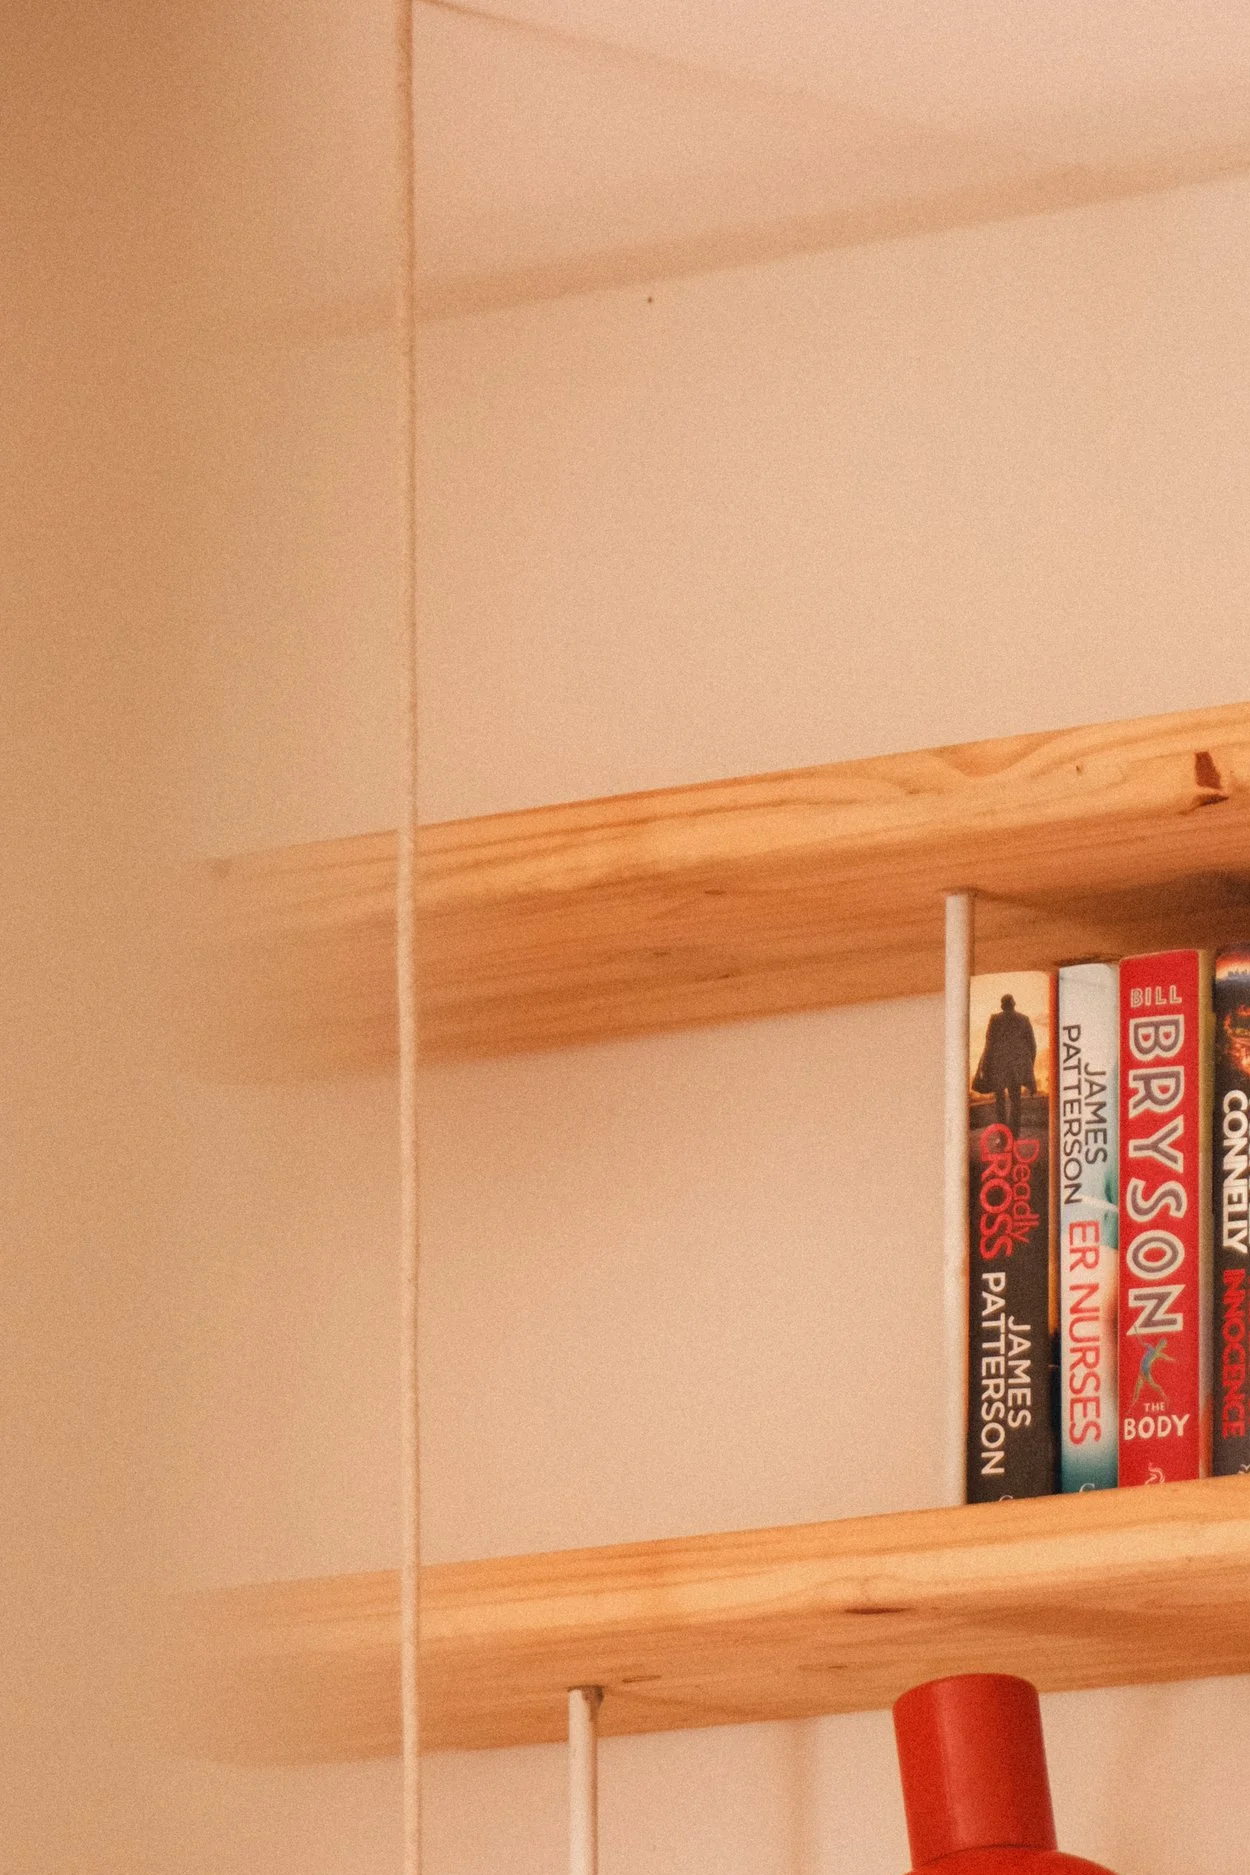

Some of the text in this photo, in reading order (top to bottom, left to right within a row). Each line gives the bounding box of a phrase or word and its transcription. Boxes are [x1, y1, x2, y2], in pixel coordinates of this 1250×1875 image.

[1130, 986, 1182, 1008] BILL
[1062, 1024, 1083, 1204] PATTERSON
[1084, 1061, 1108, 1164] JAMES
[1126, 1015, 1187, 1335] BRYSON
[1222, 1089, 1248, 1254] CONNELLY
[980, 1123, 1014, 1258] CROSS
[1010, 1136, 1040, 1244] Deadly
[981, 1272, 1005, 1475] PATTERSON
[1008, 1315, 1031, 1428] JAMES
[1068, 1220, 1101, 1445] ER NURSES
[1222, 1270, 1246, 1438] INNOCENCE
[1124, 1413, 1189, 1441] BODY
[1143, 1402, 1166, 1412] THE
